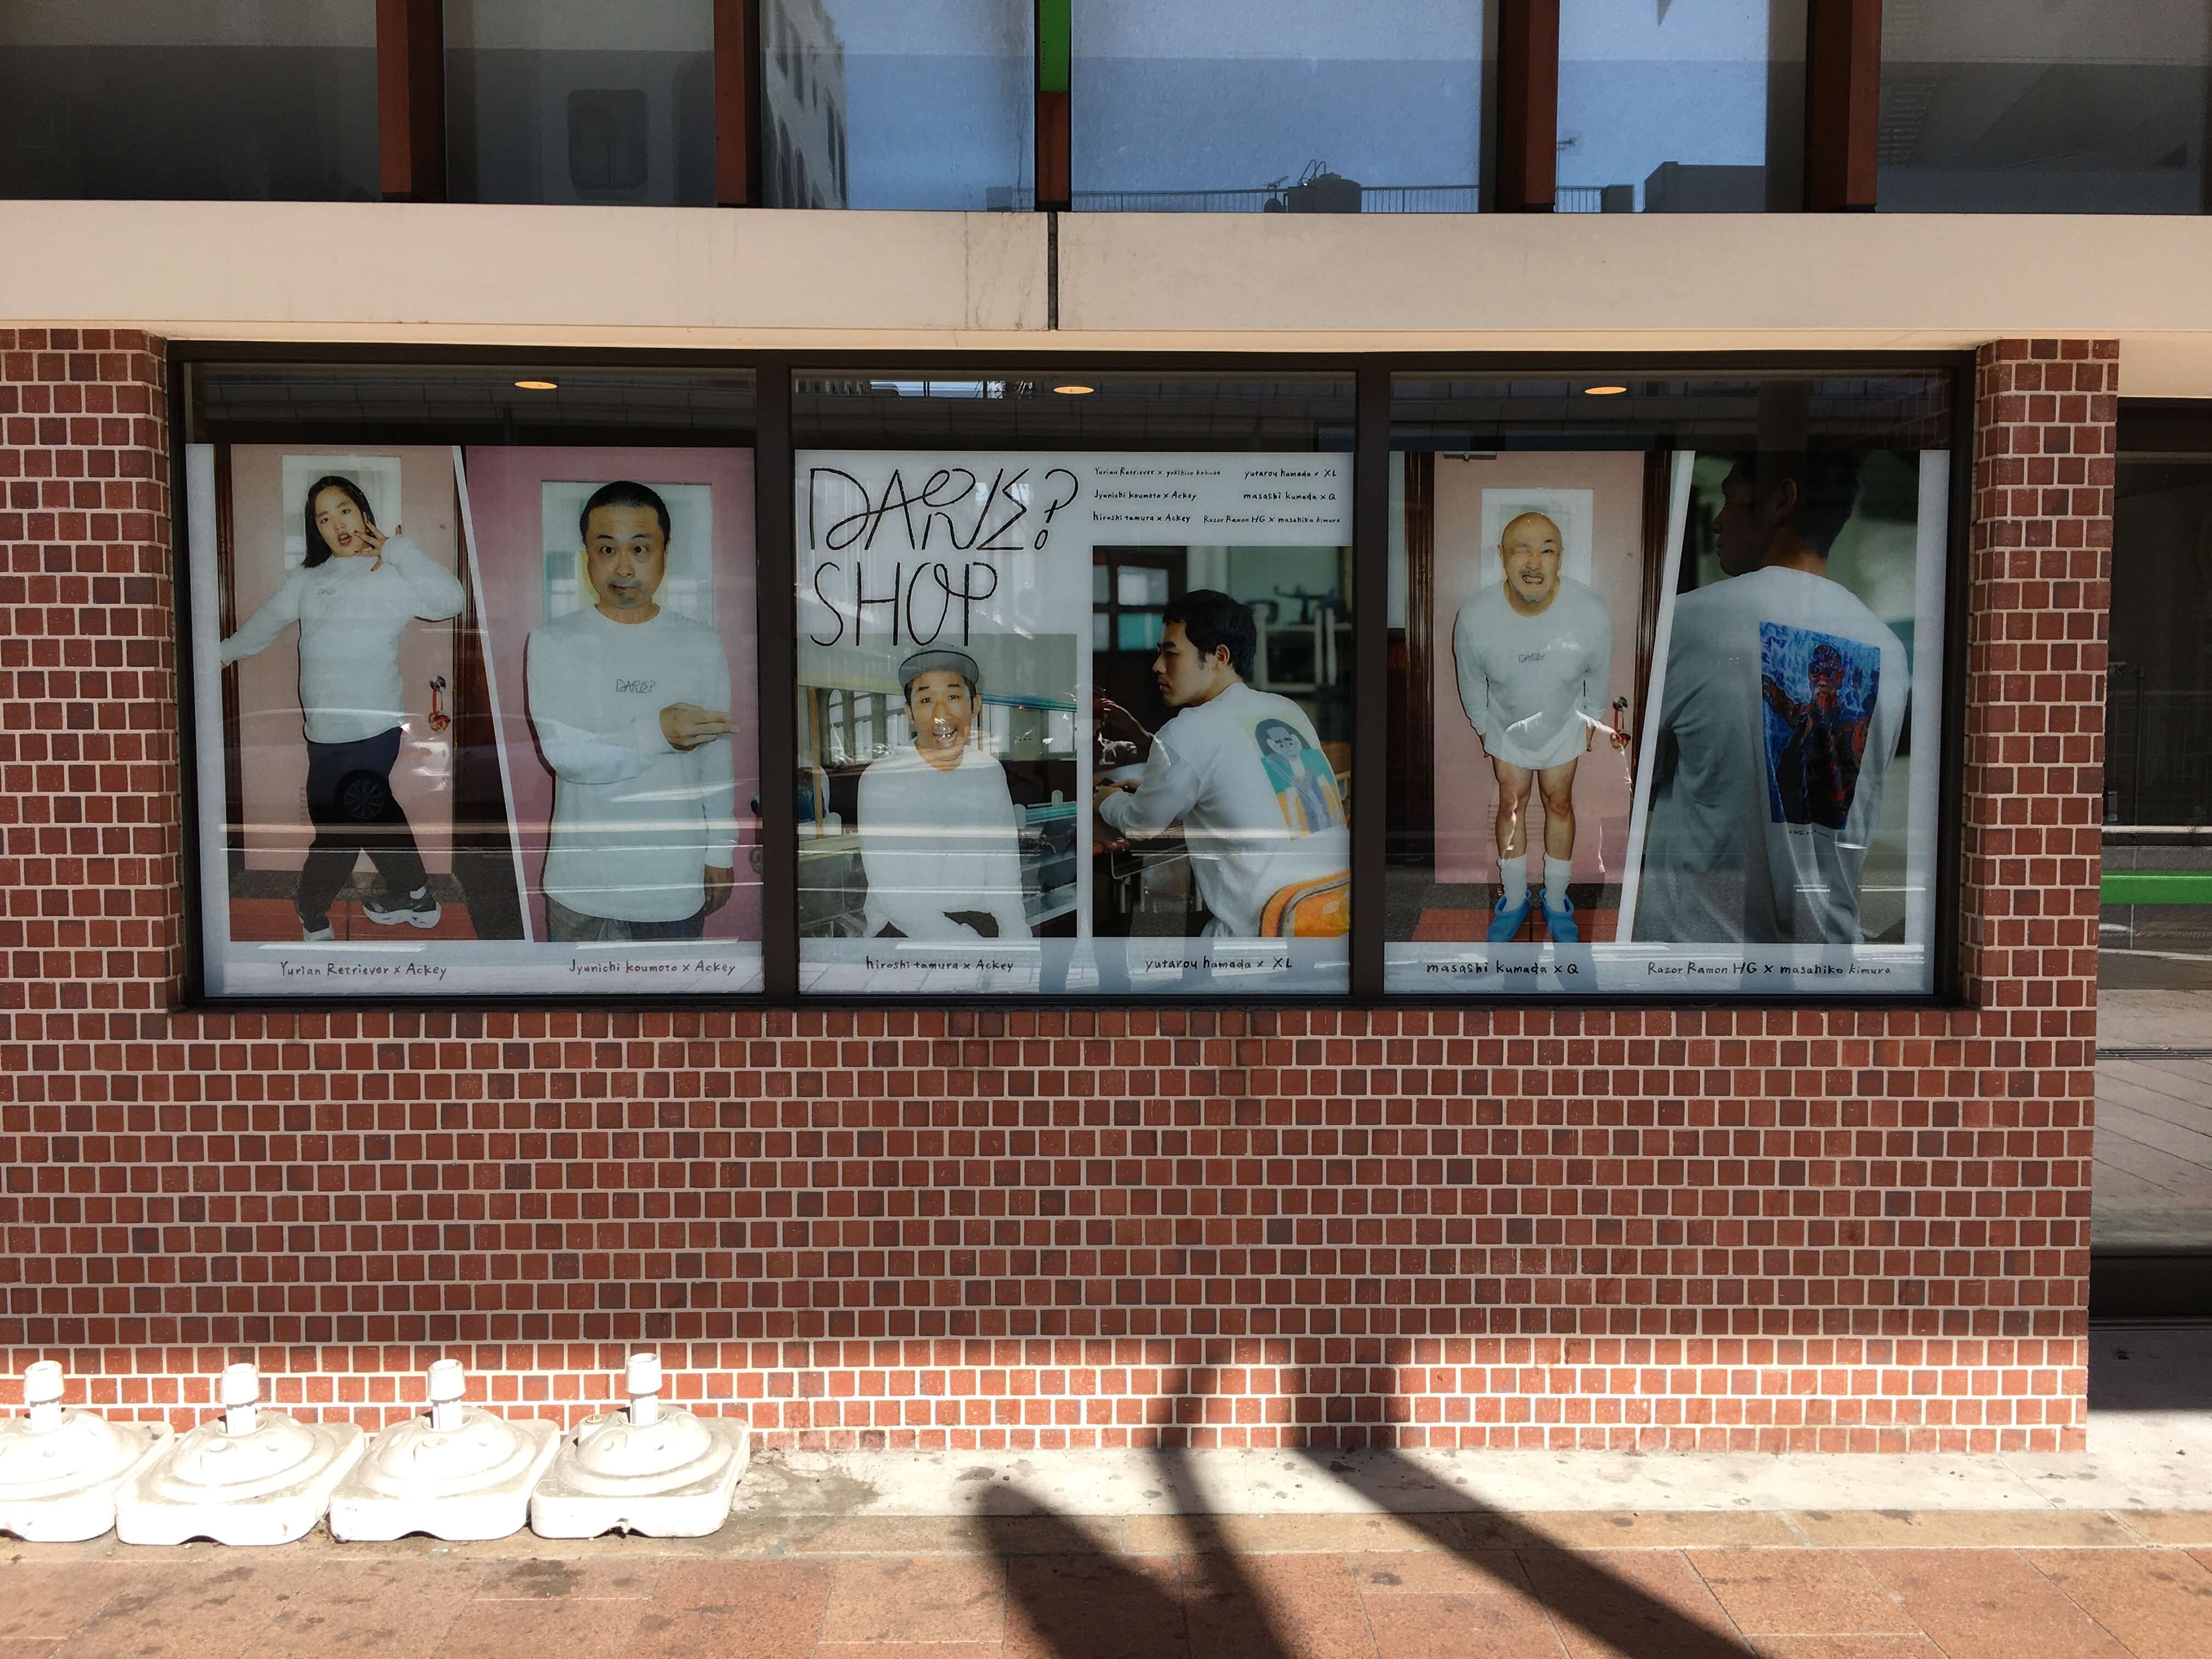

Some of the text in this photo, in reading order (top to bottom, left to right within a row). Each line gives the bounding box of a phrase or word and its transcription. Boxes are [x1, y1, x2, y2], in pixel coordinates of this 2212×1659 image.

[1095, 467, 1118, 476] Yurian
[1280, 468, 1311, 477] hamada
[1323, 469, 1337, 478] XL
[1094, 489, 1126, 500] Jyunichi
[1128, 491, 1161, 499] koumoto
[1171, 490, 1197, 501] Ackey
[1243, 492, 1282, 500] masashi
[1285, 491, 1317, 501] kumada
[1093, 511, 1122, 521] hiroshi
[1165, 514, 1191, 523] Ackey
[1203, 515, 1224, 523] Razor
[1226, 515, 1249, 523] Ramon
[810, 561, 998, 646] SHOP
[569, 959, 620, 974] Jyunichi
[626, 961, 678, 973] koumoto
[695, 960, 736, 975] Ackey
[866, 955, 910, 970] hiroshi
[913, 961, 958, 970] tamura
[975, 959, 1014, 973] Ackey
[1203, 955, 1251, 969] hamada
[1272, 957, 1293, 969] XL
[1426, 962, 1488, 973] masashi
[1496, 960, 1548, 975] kumada
[1567, 963, 1579, 974] Q
[1648, 962, 1683, 975] Razor
[1687, 961, 1728, 975] Ramon
[1733, 962, 1757, 974] HG
[1780, 964, 1844, 974] masahiko
[1849, 963, 1892, 975] kimura
[280, 961, 321, 976] Yurian
[327, 963, 388, 976] Retriever
[405, 963, 447, 980] Ackey
